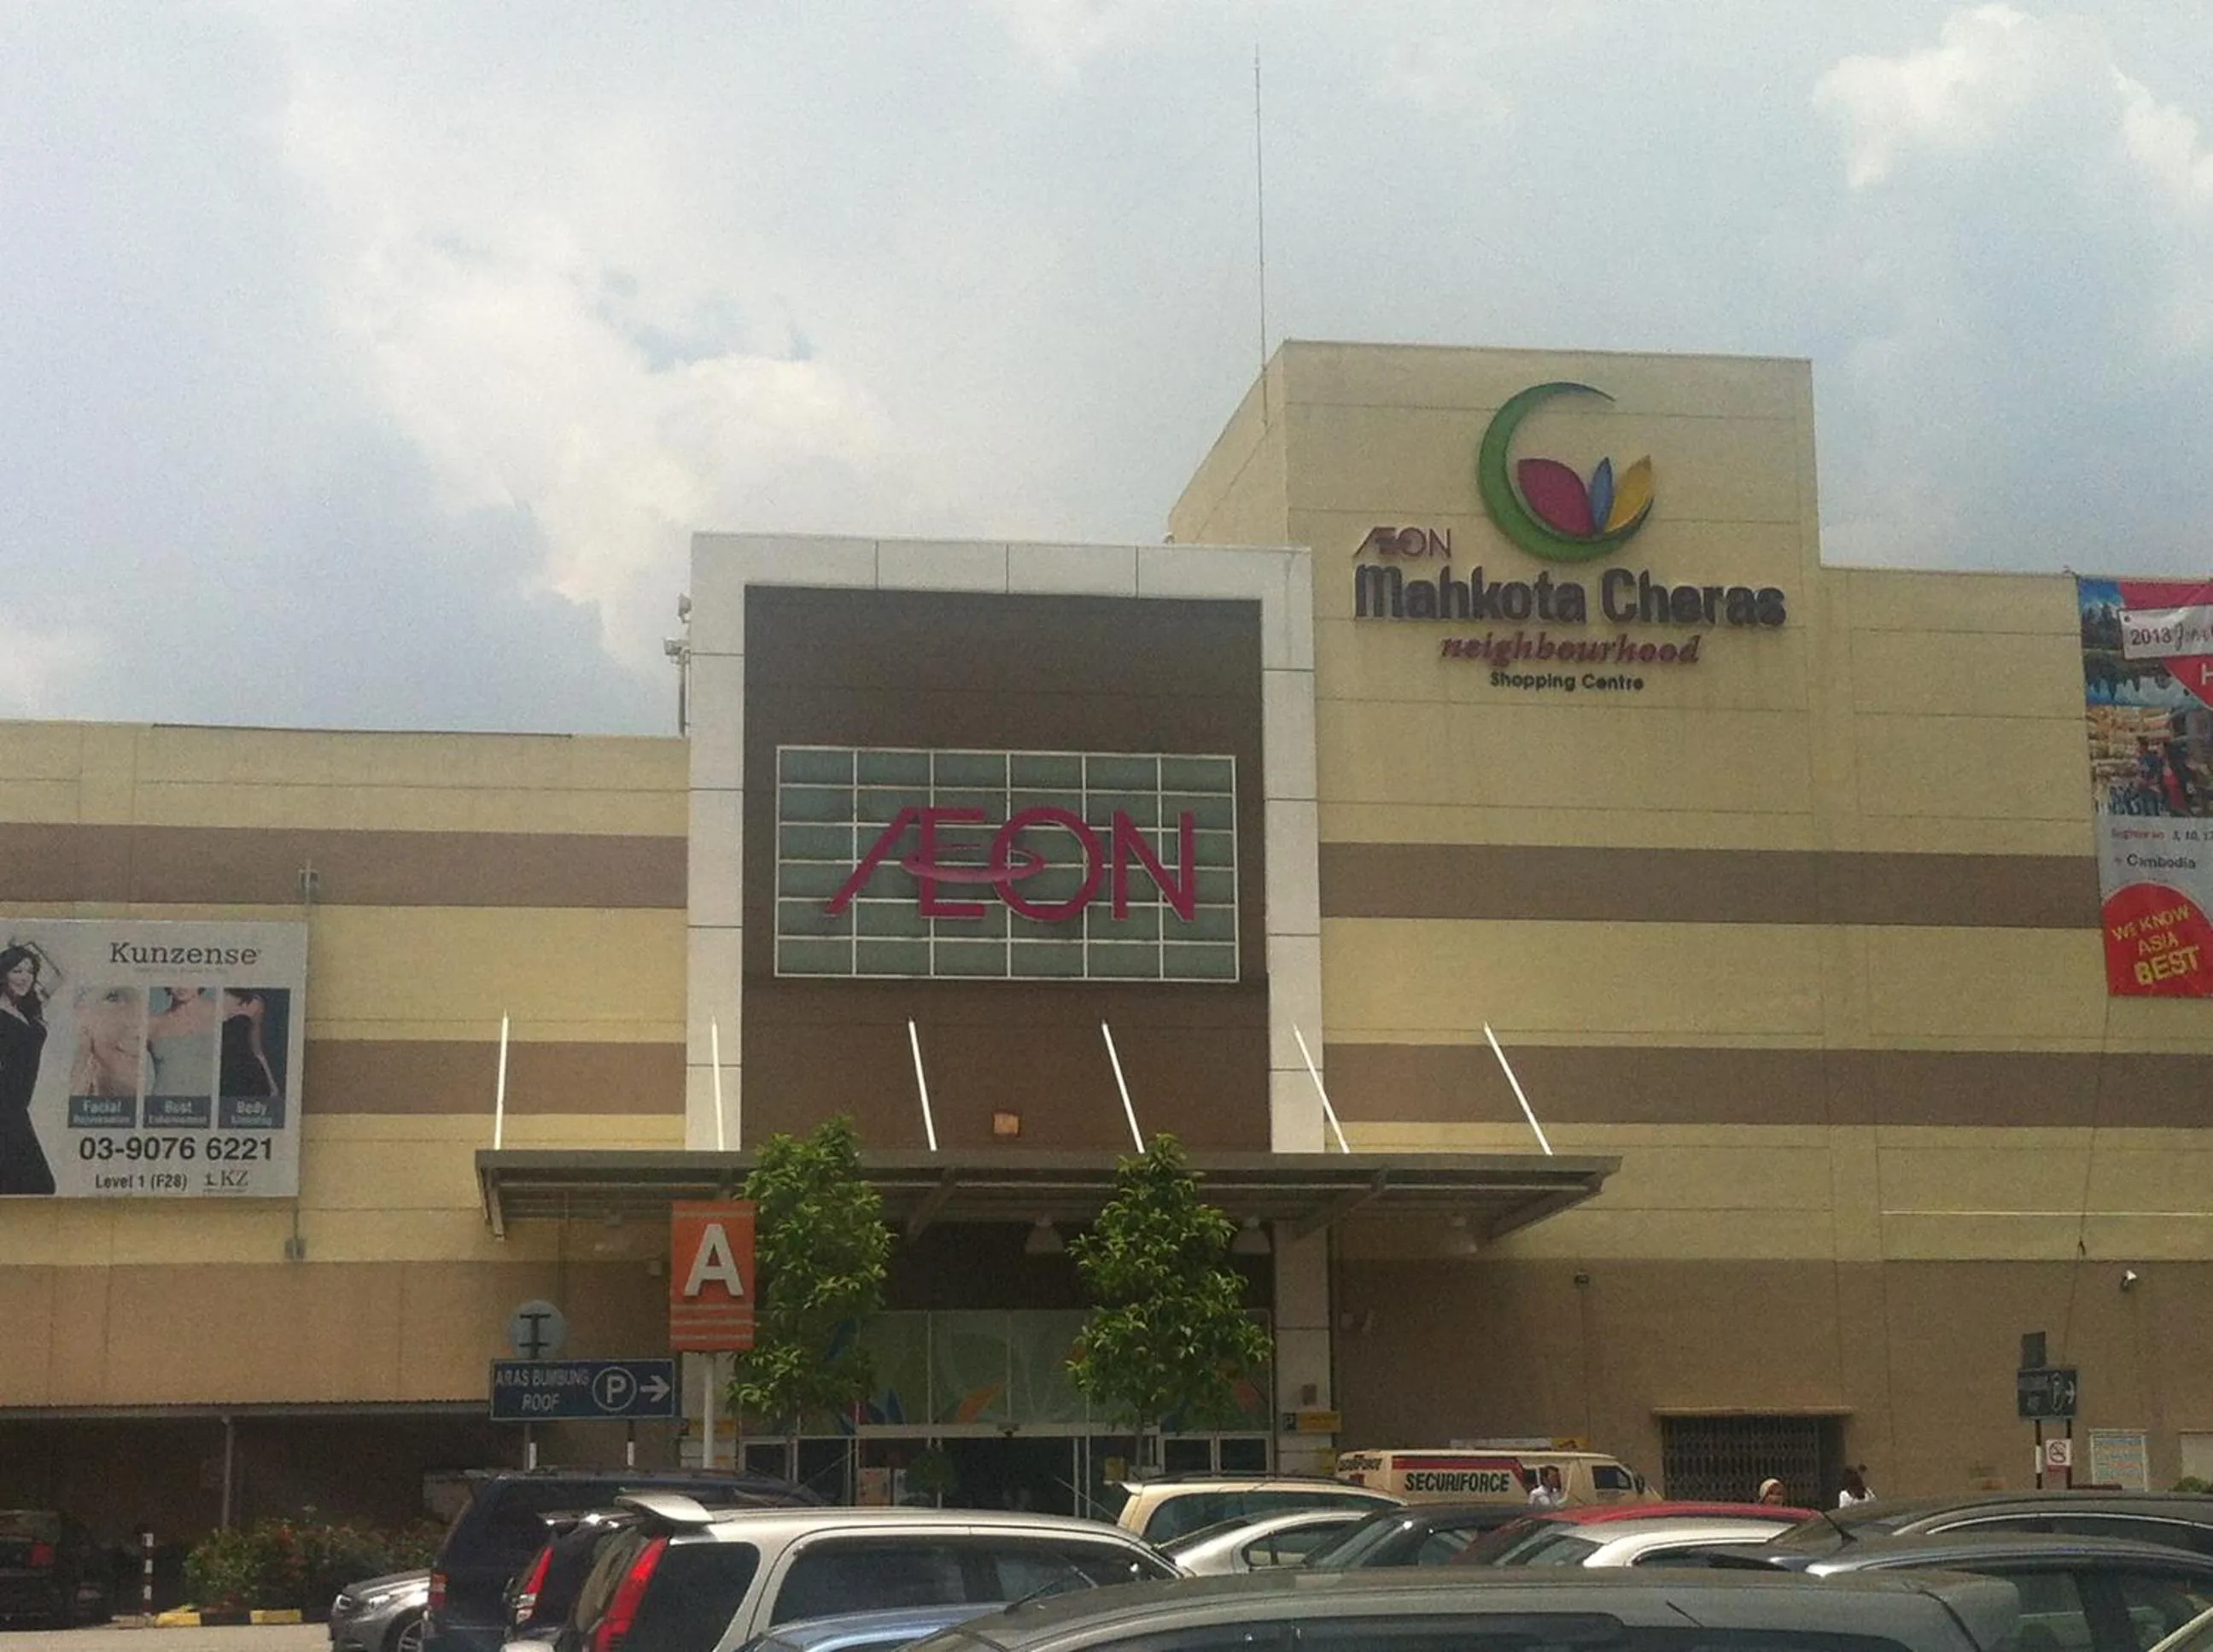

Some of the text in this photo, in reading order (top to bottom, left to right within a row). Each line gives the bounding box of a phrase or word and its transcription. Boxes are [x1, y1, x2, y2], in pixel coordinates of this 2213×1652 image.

[1601, 567, 1786, 626] Cheras
[1440, 632, 1701, 668] neighbourhood
[1490, 671, 1644, 692] Shopping Centre
[2141, 904, 2190, 931] KNOW
[110, 942, 258, 965] Kunzense
[2134, 946, 2200, 985] BEST
[79, 1136, 272, 1160] 03-9076 6221
[96, 1174, 133, 1188] Level
[140, 1174, 144, 1188] 1
[684, 1223, 744, 1297] A
[1404, 1472, 1509, 1493] SECURIFORCE
